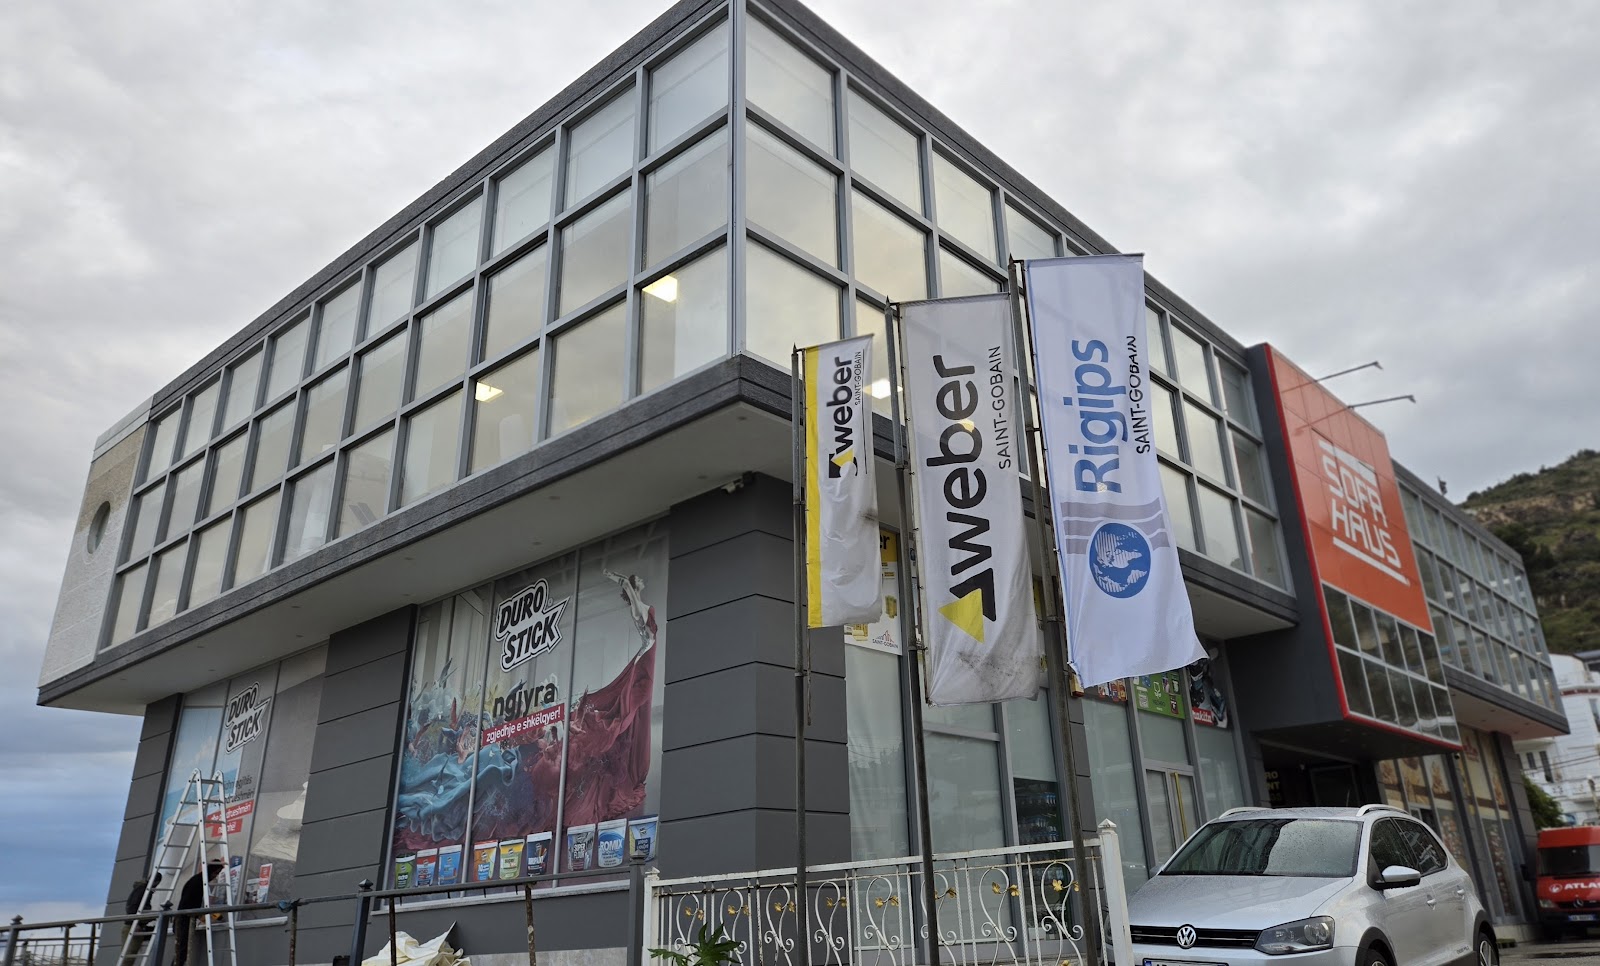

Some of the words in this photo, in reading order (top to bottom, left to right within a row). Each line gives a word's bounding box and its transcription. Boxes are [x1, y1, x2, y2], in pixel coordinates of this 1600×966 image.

[826, 356, 853, 455] weber
[988, 345, 1011, 470] SAINT-GOBAIN
[1063, 339, 1128, 493] Rigips
[1126, 335, 1150, 454] SAINT-GOBAIN
[926, 354, 992, 576] weber
[1322, 454, 1387, 527] SOFA
[1332, 499, 1401, 568] HAUS
[499, 586, 544, 633] DURO
[505, 613, 558, 664] STICK
[228, 687, 257, 723] DURO
[228, 708, 262, 747] STICK
[486, 723, 515, 744] zgjedhje
[517, 723, 521, 732] e
[522, 706, 560, 730] shkëlqyer!
[493, 682, 557, 722] ngjyra
